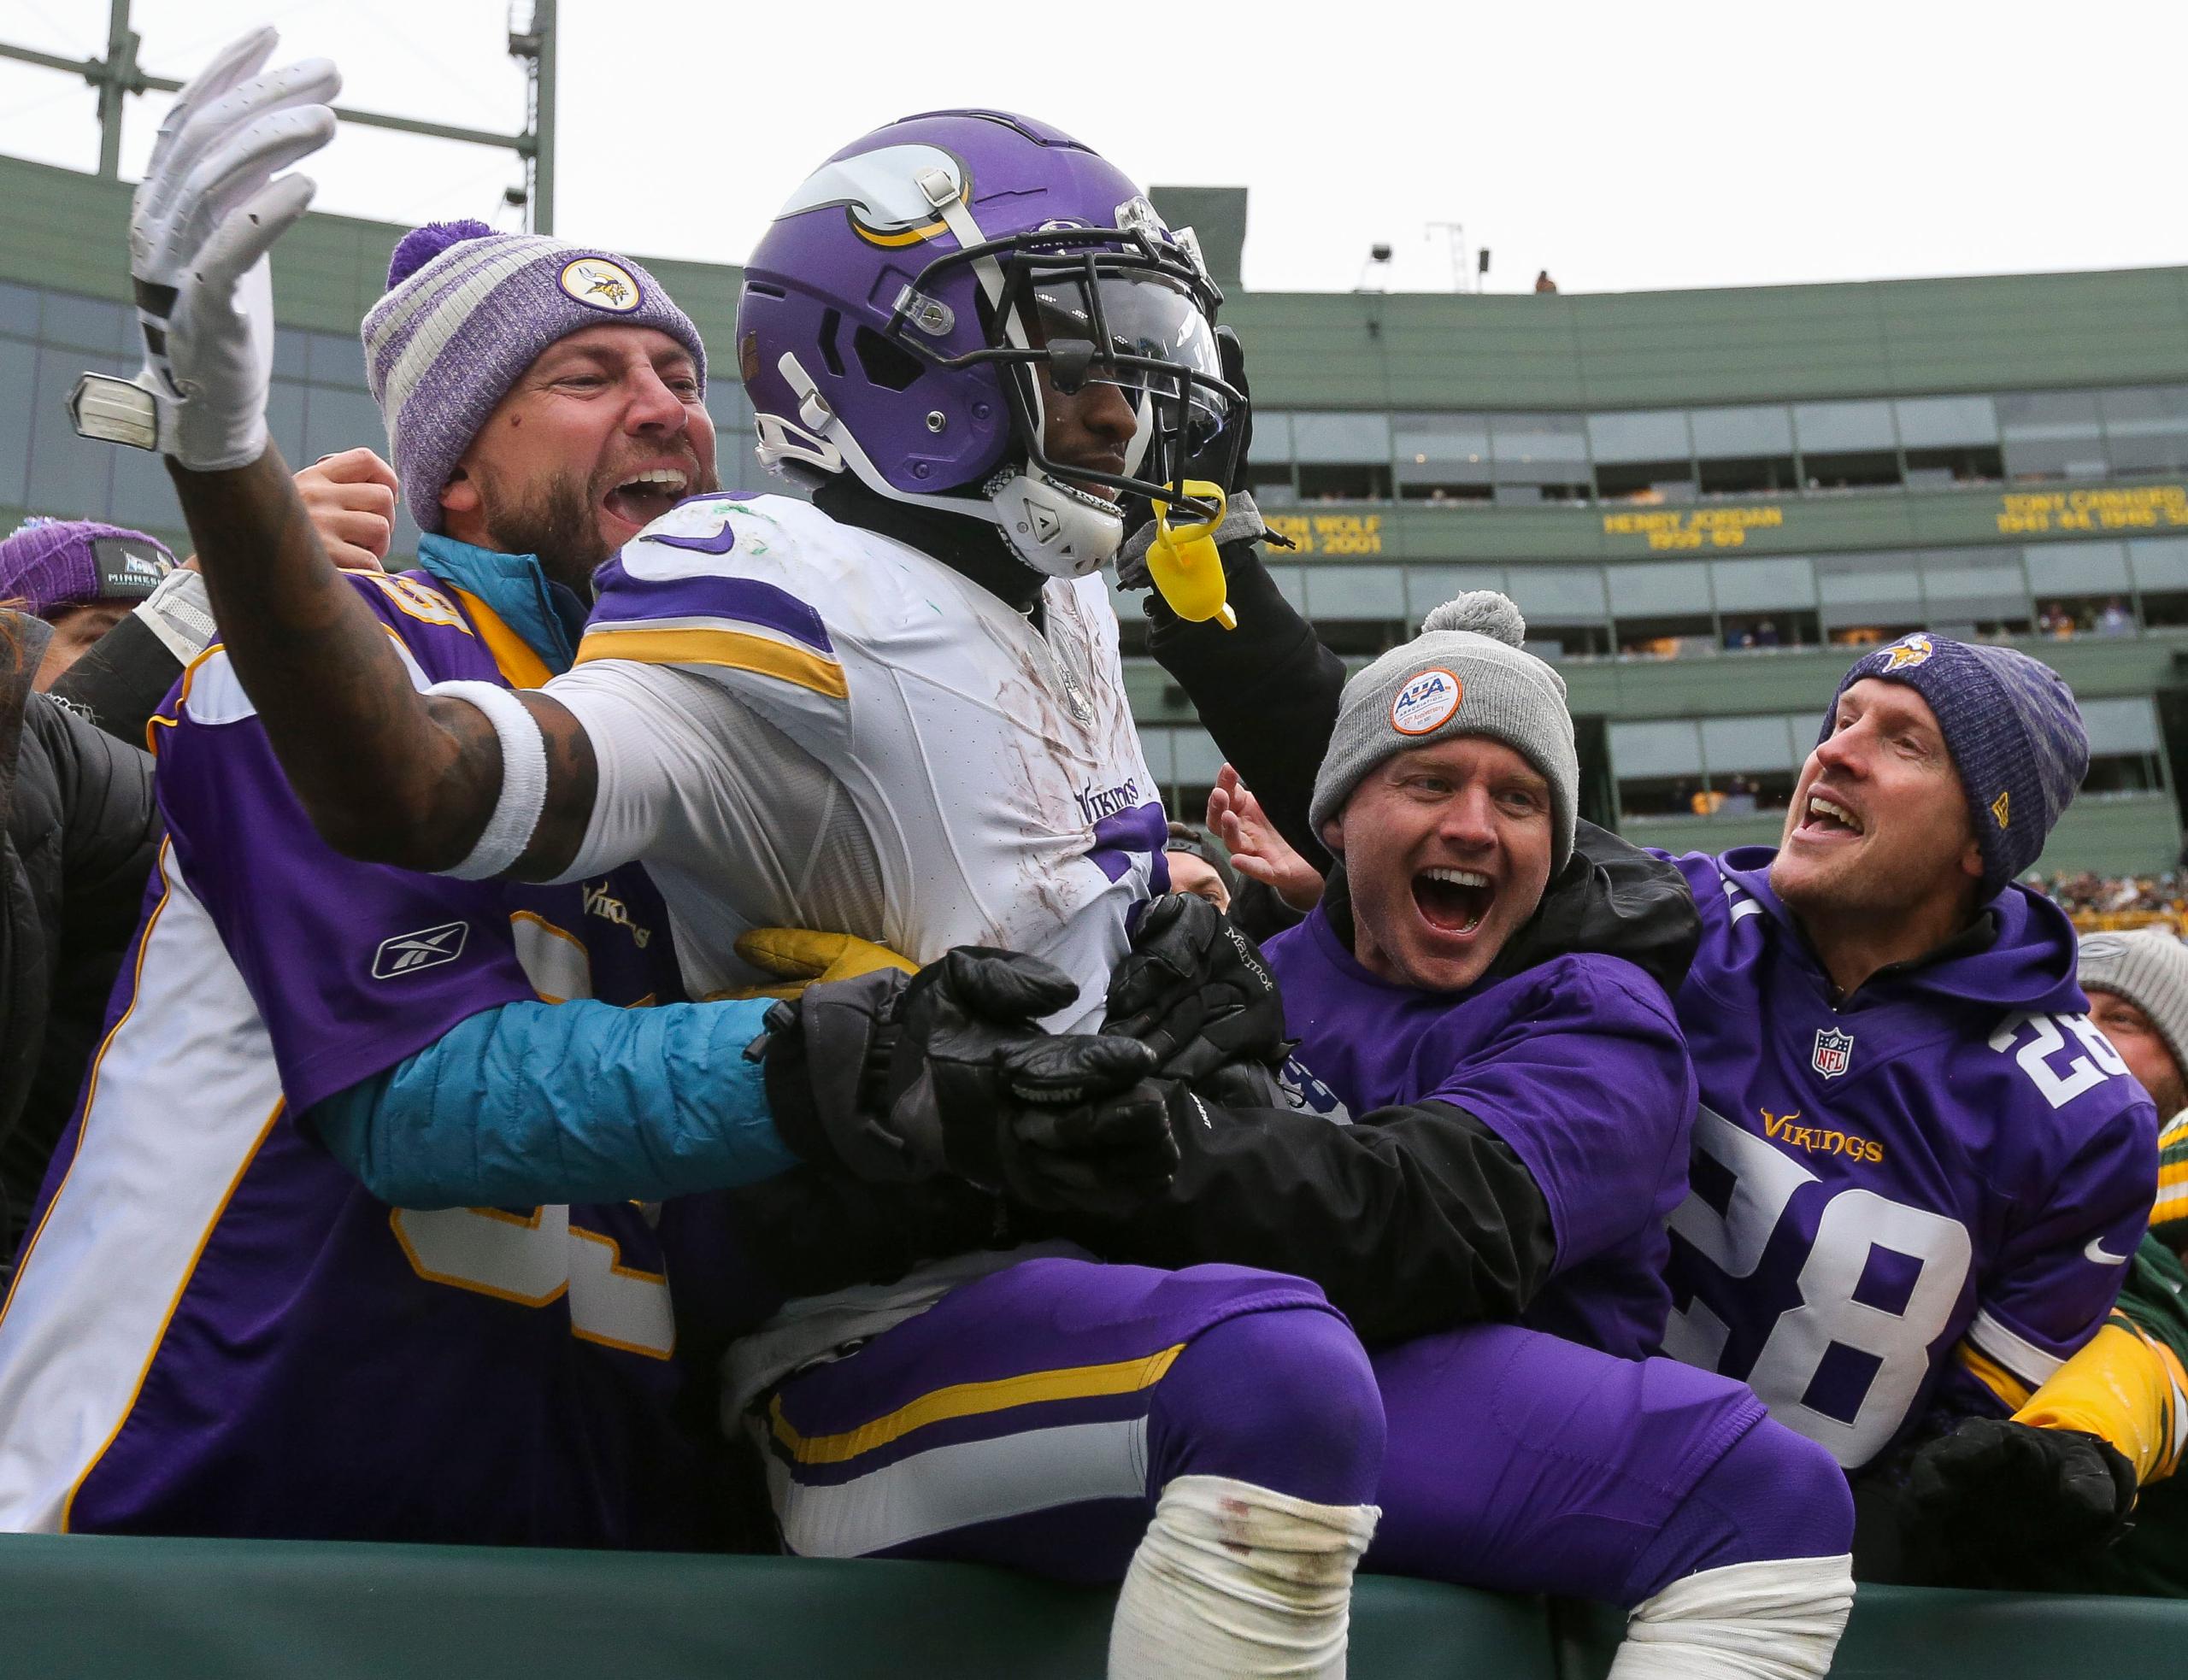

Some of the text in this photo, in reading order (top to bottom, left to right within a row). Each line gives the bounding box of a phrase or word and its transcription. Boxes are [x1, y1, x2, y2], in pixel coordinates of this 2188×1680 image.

[1313, 514, 1382, 534] WOLF
[1604, 507, 1783, 534] HENRY JORDAN
[1224, 926, 1273, 991] Marmot
[1817, 1049, 1843, 1072] NFL
